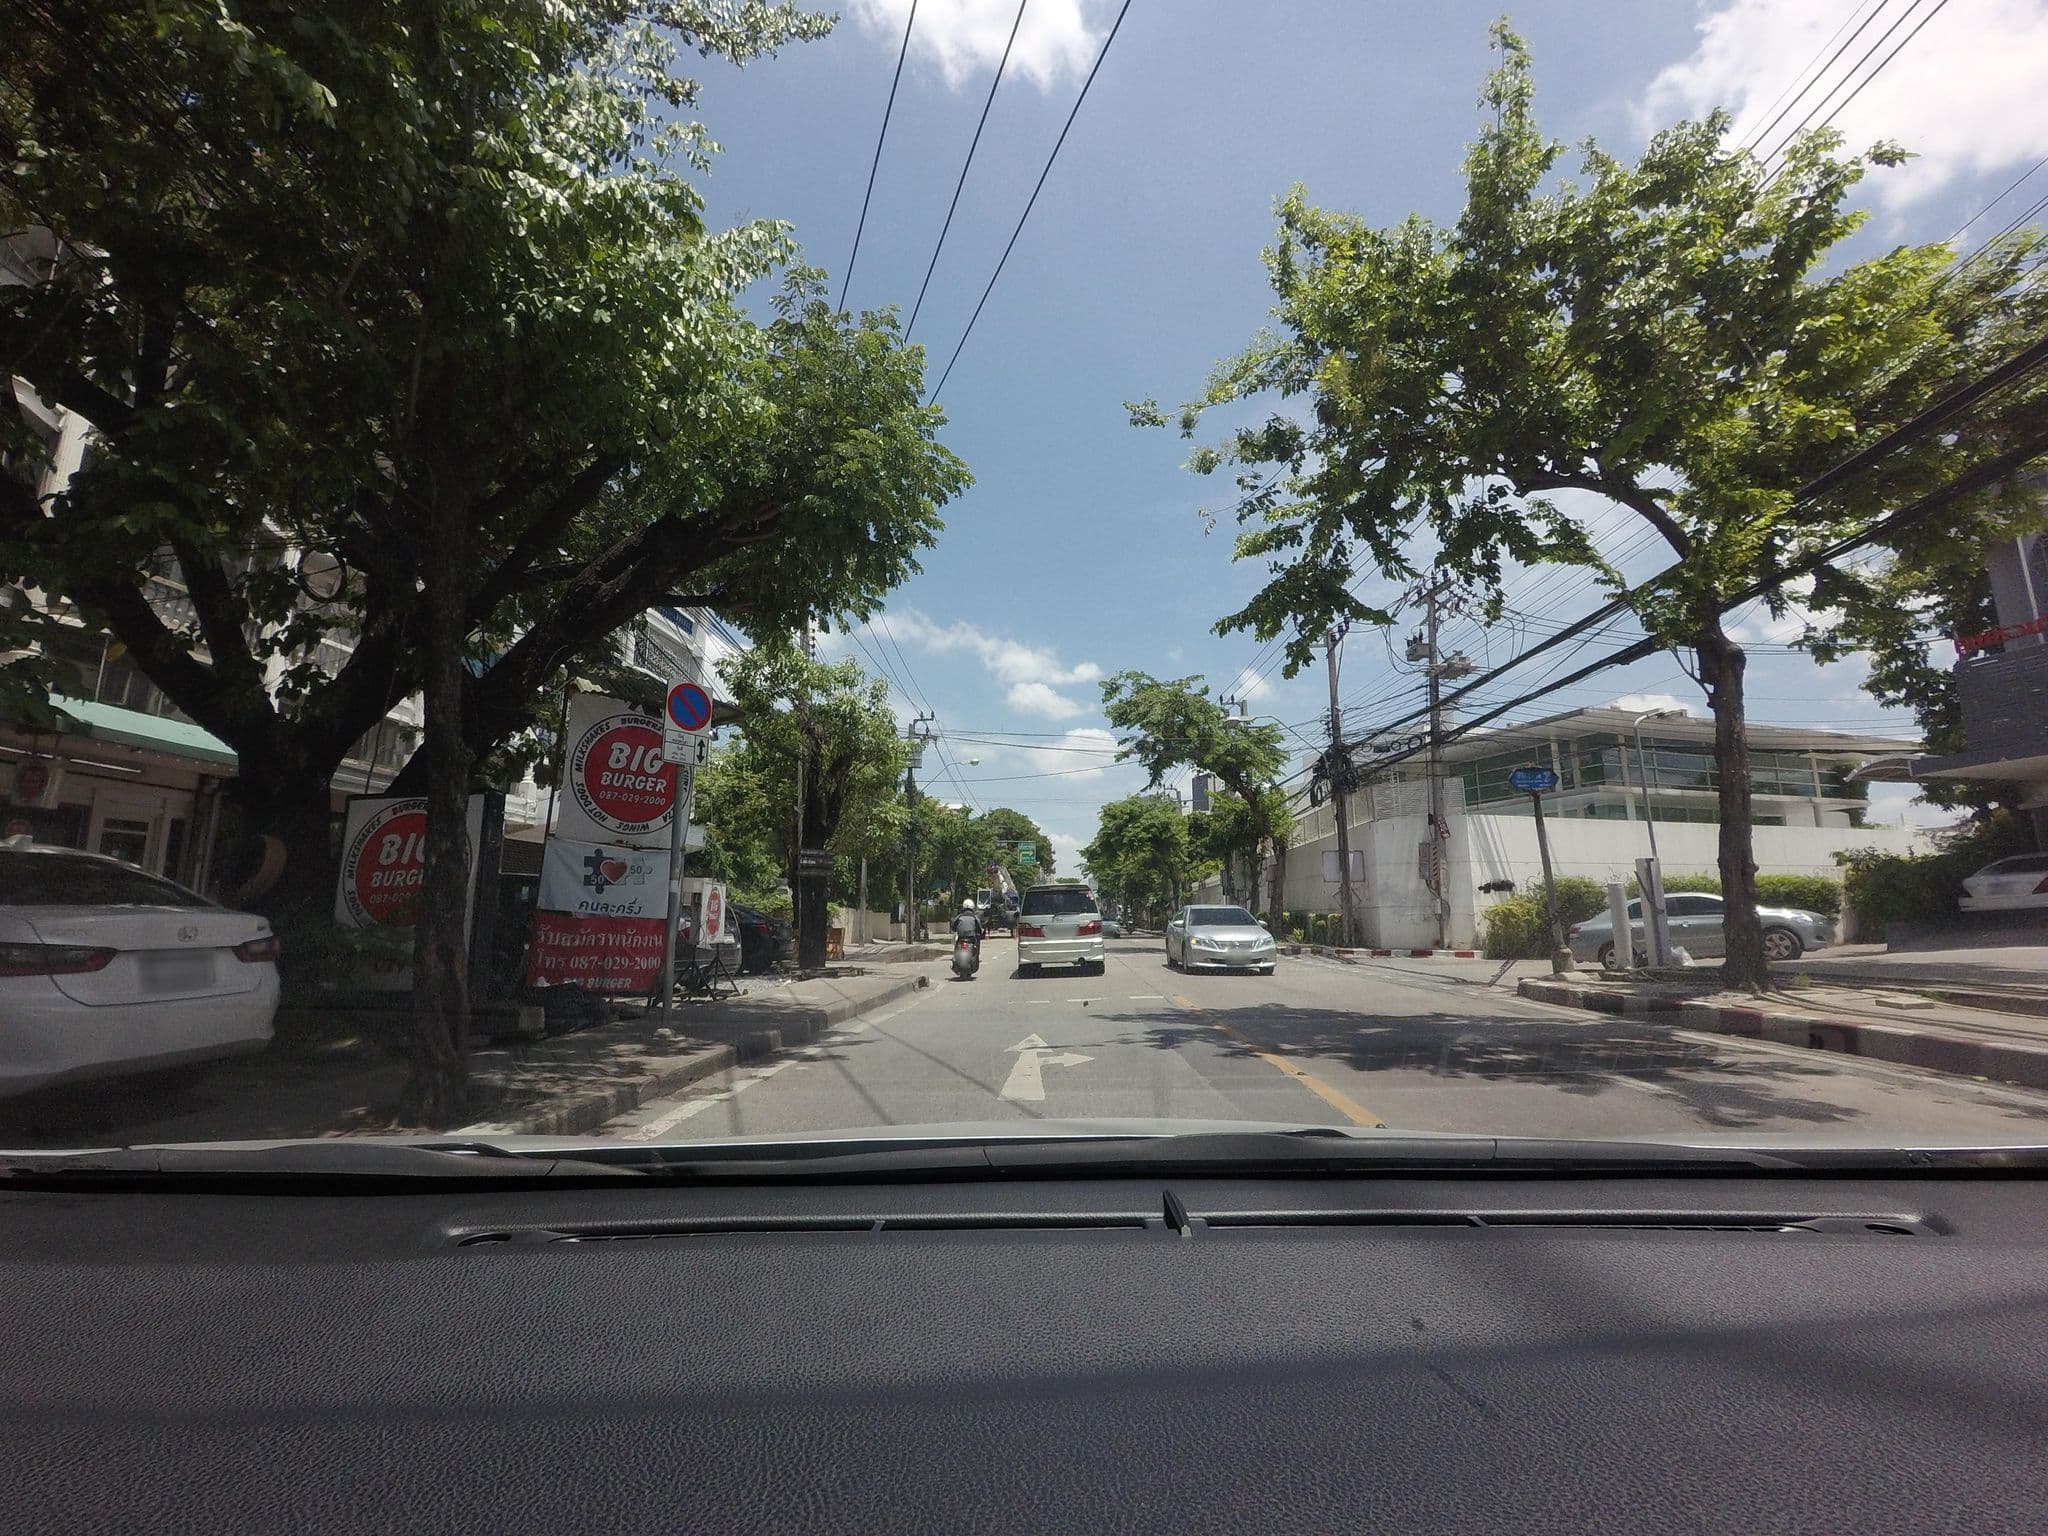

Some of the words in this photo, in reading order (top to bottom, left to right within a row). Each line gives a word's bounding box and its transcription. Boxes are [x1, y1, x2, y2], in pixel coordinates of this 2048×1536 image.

[575, 721, 611, 774] MILKSHAKES
[608, 741, 665, 774] BIG
[600, 771, 667, 794] BURGER
[575, 781, 592, 807] DOGS
[599, 791, 666, 807] 087-029-2000
[588, 804, 609, 823] HOT
[616, 822, 650, 833] WINGS
[370, 868, 424, 888] BURG
[630, 866, 642, 875] 50
[590, 875, 606, 886] 50
[577, 897, 643, 915] คนละครึ่ง
[569, 956, 662, 971] 087-029-2000
[587, 978, 632, 989] BURGER
